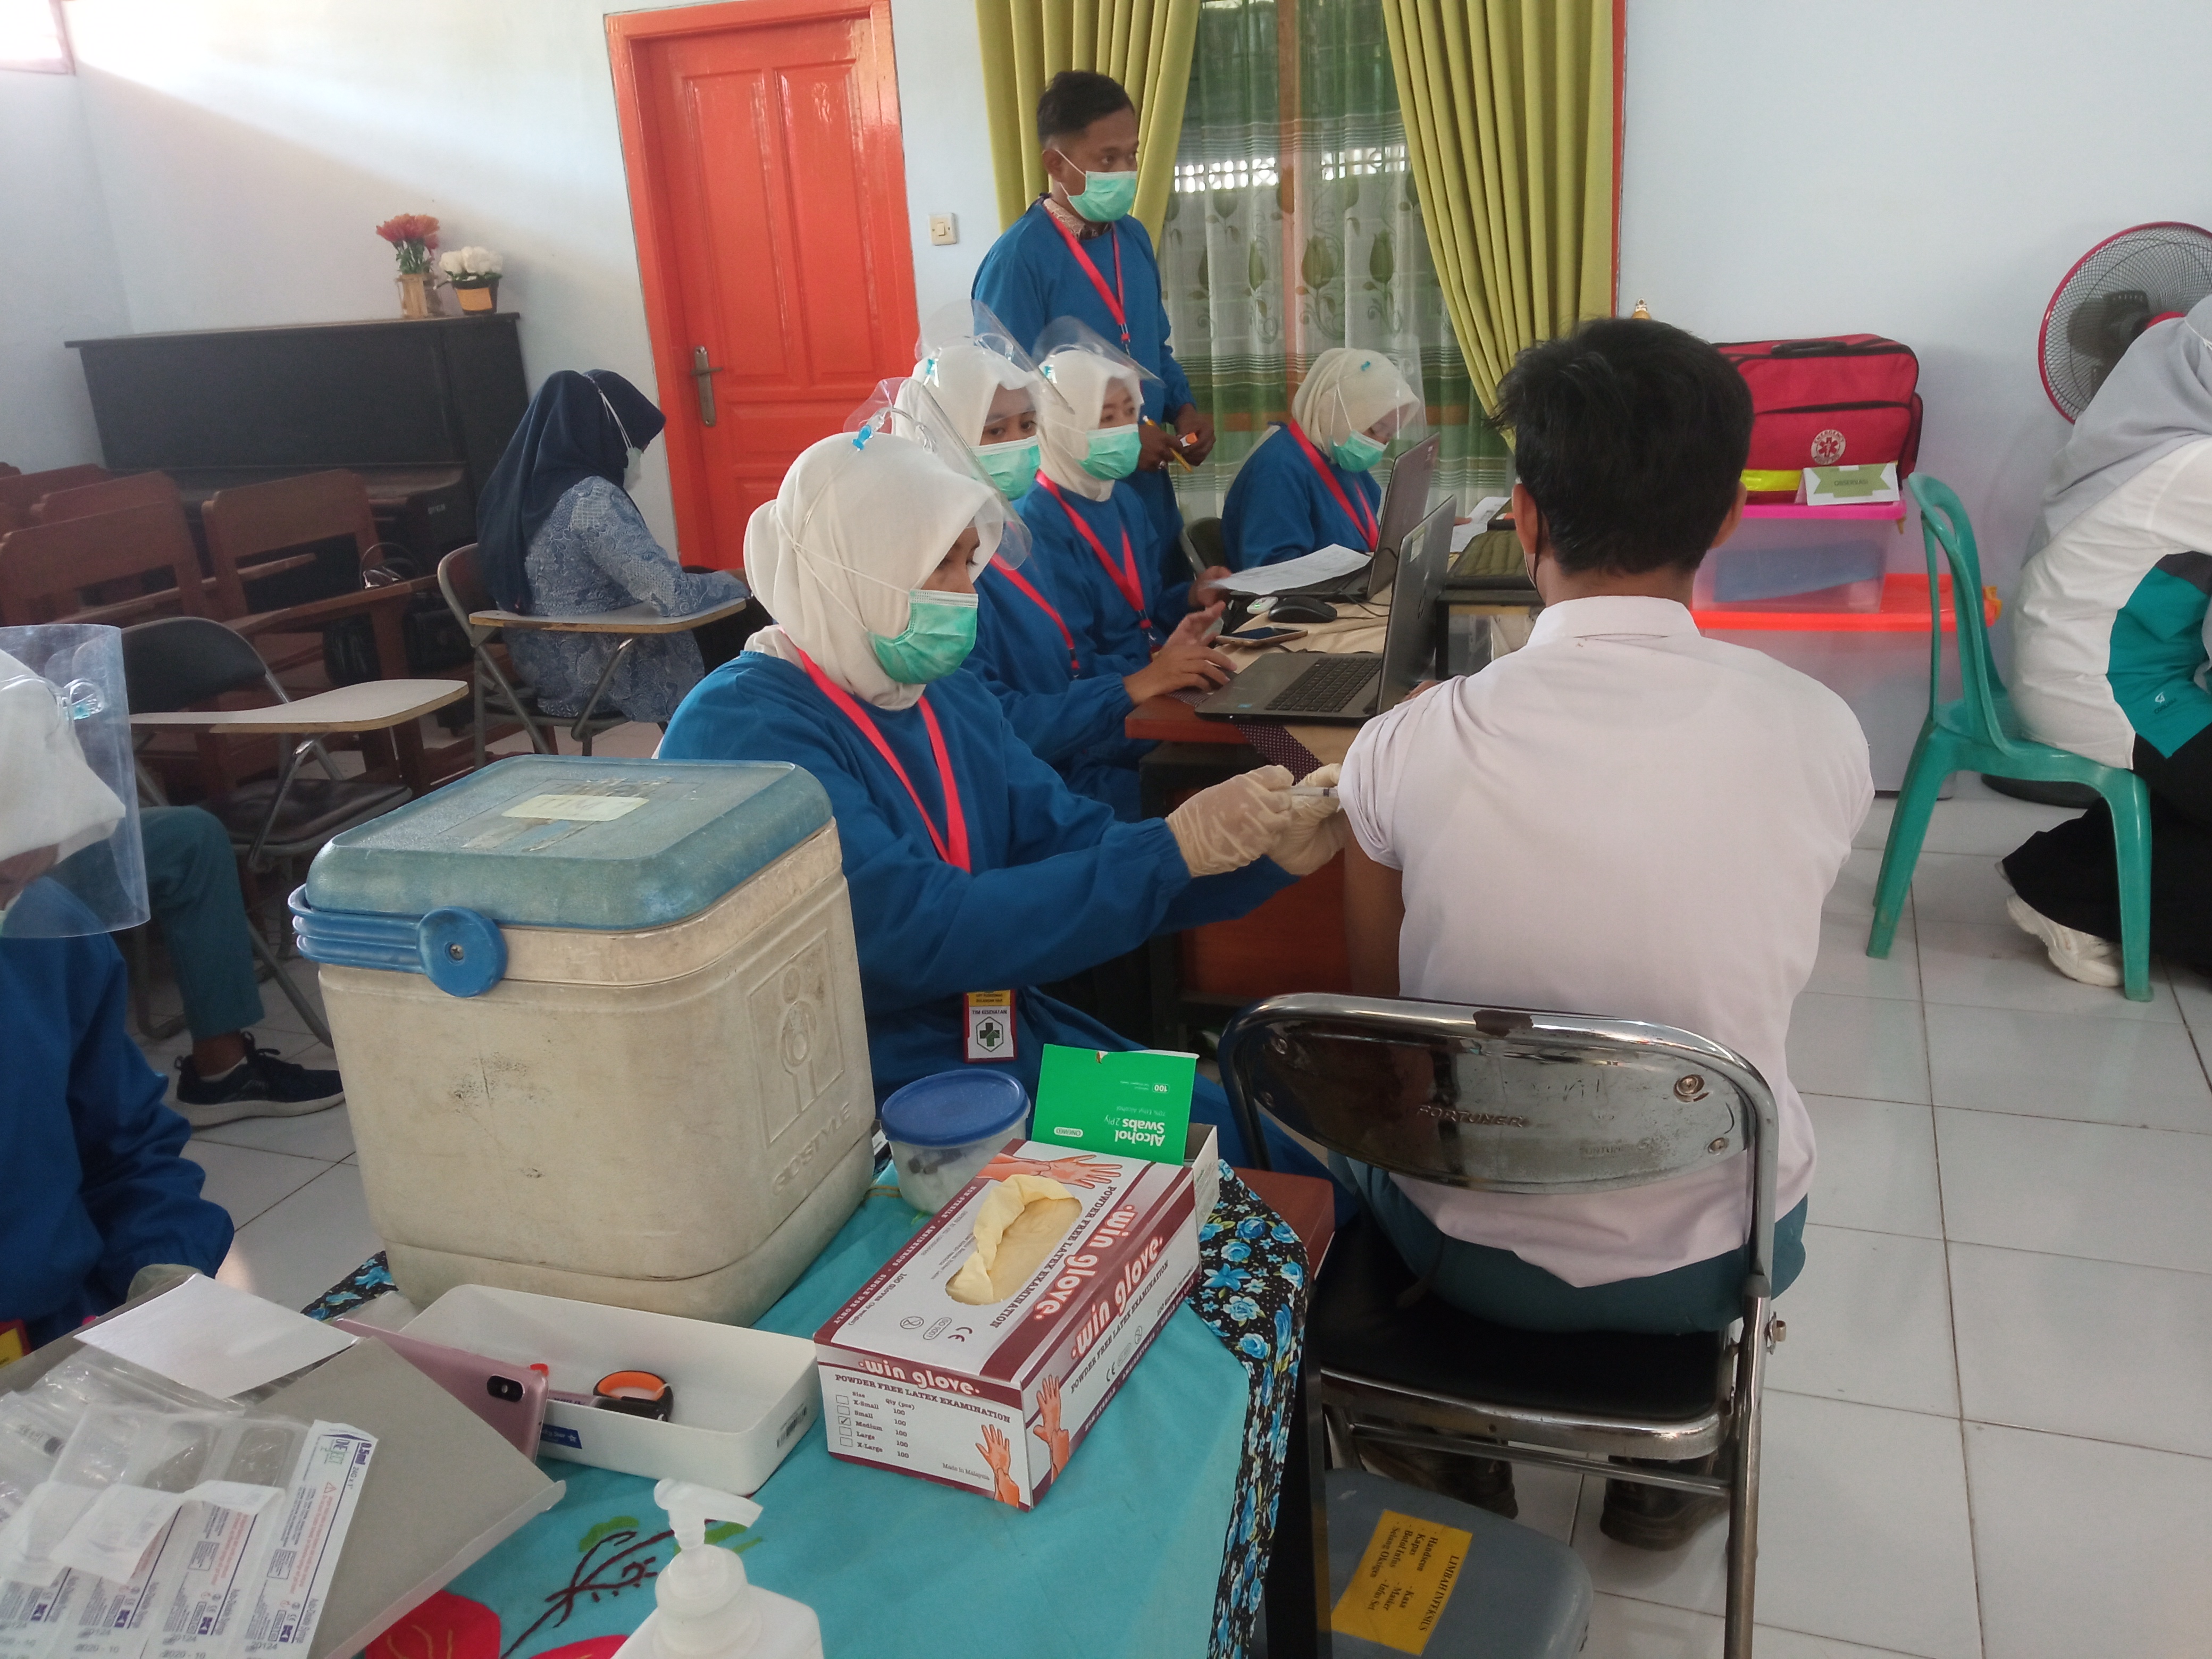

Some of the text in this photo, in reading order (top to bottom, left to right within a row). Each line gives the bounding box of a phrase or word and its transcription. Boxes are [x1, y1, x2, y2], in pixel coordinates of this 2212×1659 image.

[1104, 1114, 1166, 1134] Swabs 2Ply
[1417, 1104, 1522, 1127] FORTUNER
[1115, 1129, 1166, 1147] Alcohol
[941, 1185, 977, 1219] NON-STERILE
[892, 1225, 936, 1267] AMBIDEXTROUS
[990, 1185, 1117, 1328] POWDER FREE LATEX EXAMINATION
[864, 1273, 887, 1296] SINGLE
[893, 1272, 907, 1284] 100
[850, 1294, 865, 1308] USE
[874, 1283, 896, 1302] Gloves
[833, 1308, 852, 1325] ONLY
[1071, 1358, 1096, 1394] POWDER
[1095, 1337, 1113, 1360] FREE
[1112, 1311, 1132, 1339] LATEX
[1130, 1260, 1169, 1317] EXAMINATION
[834, 1373, 1011, 1423] POWDER FREE LATEX EXAMINATION
[885, 1398, 896, 1406] Qty
[854, 1410, 874, 1419] Small
[855, 1420, 883, 1431] Medium
[856, 1431, 876, 1440] Large
[355, 1442, 372, 1465] 0.5ml
[897, 1451, 910, 1459] 100
[942, 1462, 958, 1471] Made
[965, 1468, 990, 1481] Malaysia
[1370, 1527, 1401, 1578] Selang Oksigen
[1390, 1530, 1413, 1568] Botol Infus
[1410, 1534, 1426, 1556] Kapas
[1367, 1583, 1389, 1610] Infus Set
[1383, 1587, 1402, 1611] Masker
[1399, 1590, 1415, 1608] Kasa
[1418, 1555, 1460, 1632] LIMBAH INFEKSIUS
